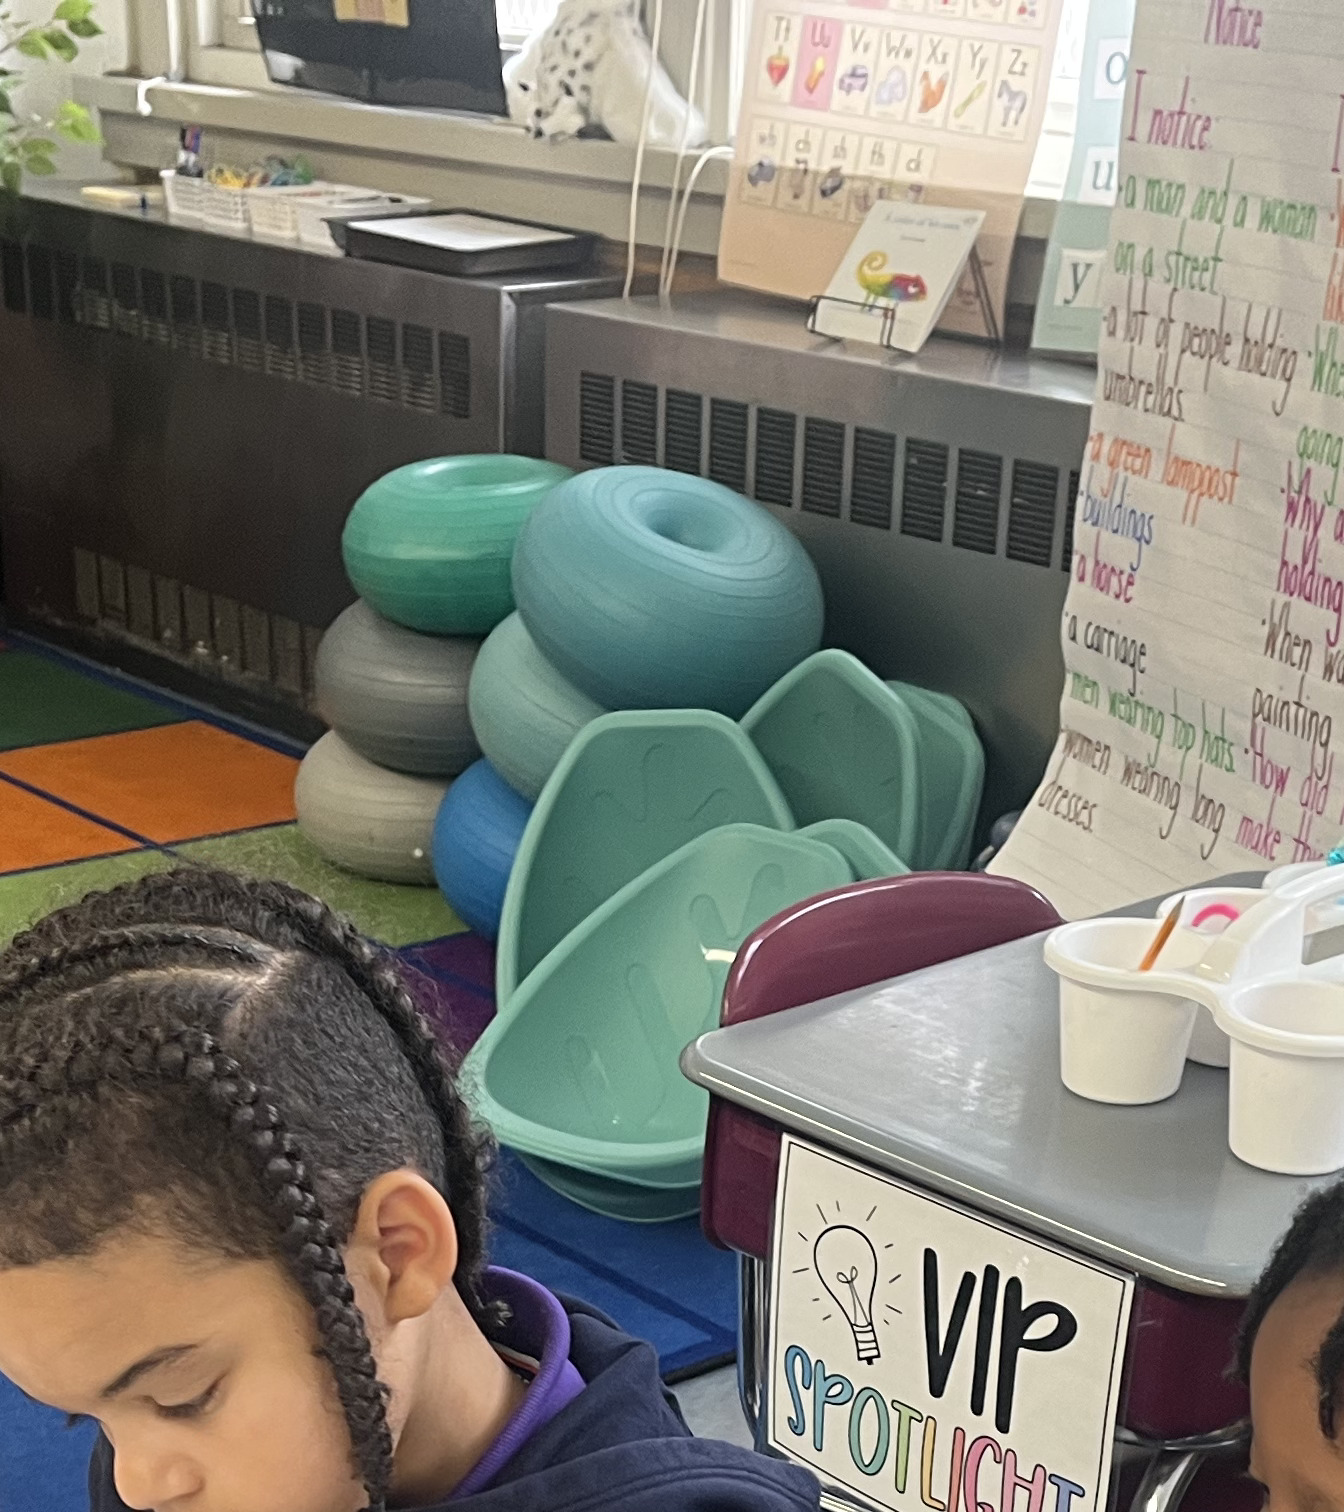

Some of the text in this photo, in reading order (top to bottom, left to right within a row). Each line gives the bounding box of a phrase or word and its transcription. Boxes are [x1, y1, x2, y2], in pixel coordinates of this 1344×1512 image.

[969, 43, 988, 79] Yy
[1008, 49, 1028, 77] Zz
[1127, 69, 1146, 142] I
[1144, 178, 1186, 217] man
[1190, 158, 1235, 224] and
[1064, 263, 1093, 304] y
[1114, 241, 1135, 276] on
[1173, 295, 1297, 416] people holding
[1162, 423, 1239, 527] lamppost
[1082, 465, 1154, 572] buildings
[1091, 531, 1135, 603] horse
[1277, 527, 1344, 647] holding
[1084, 621, 1146, 696] carriage
[1264, 598, 1312, 673] When
[1251, 674, 1332, 781] painting
[1120, 755, 1225, 860] wearing long
[924, 1247, 1078, 1434] VIP
